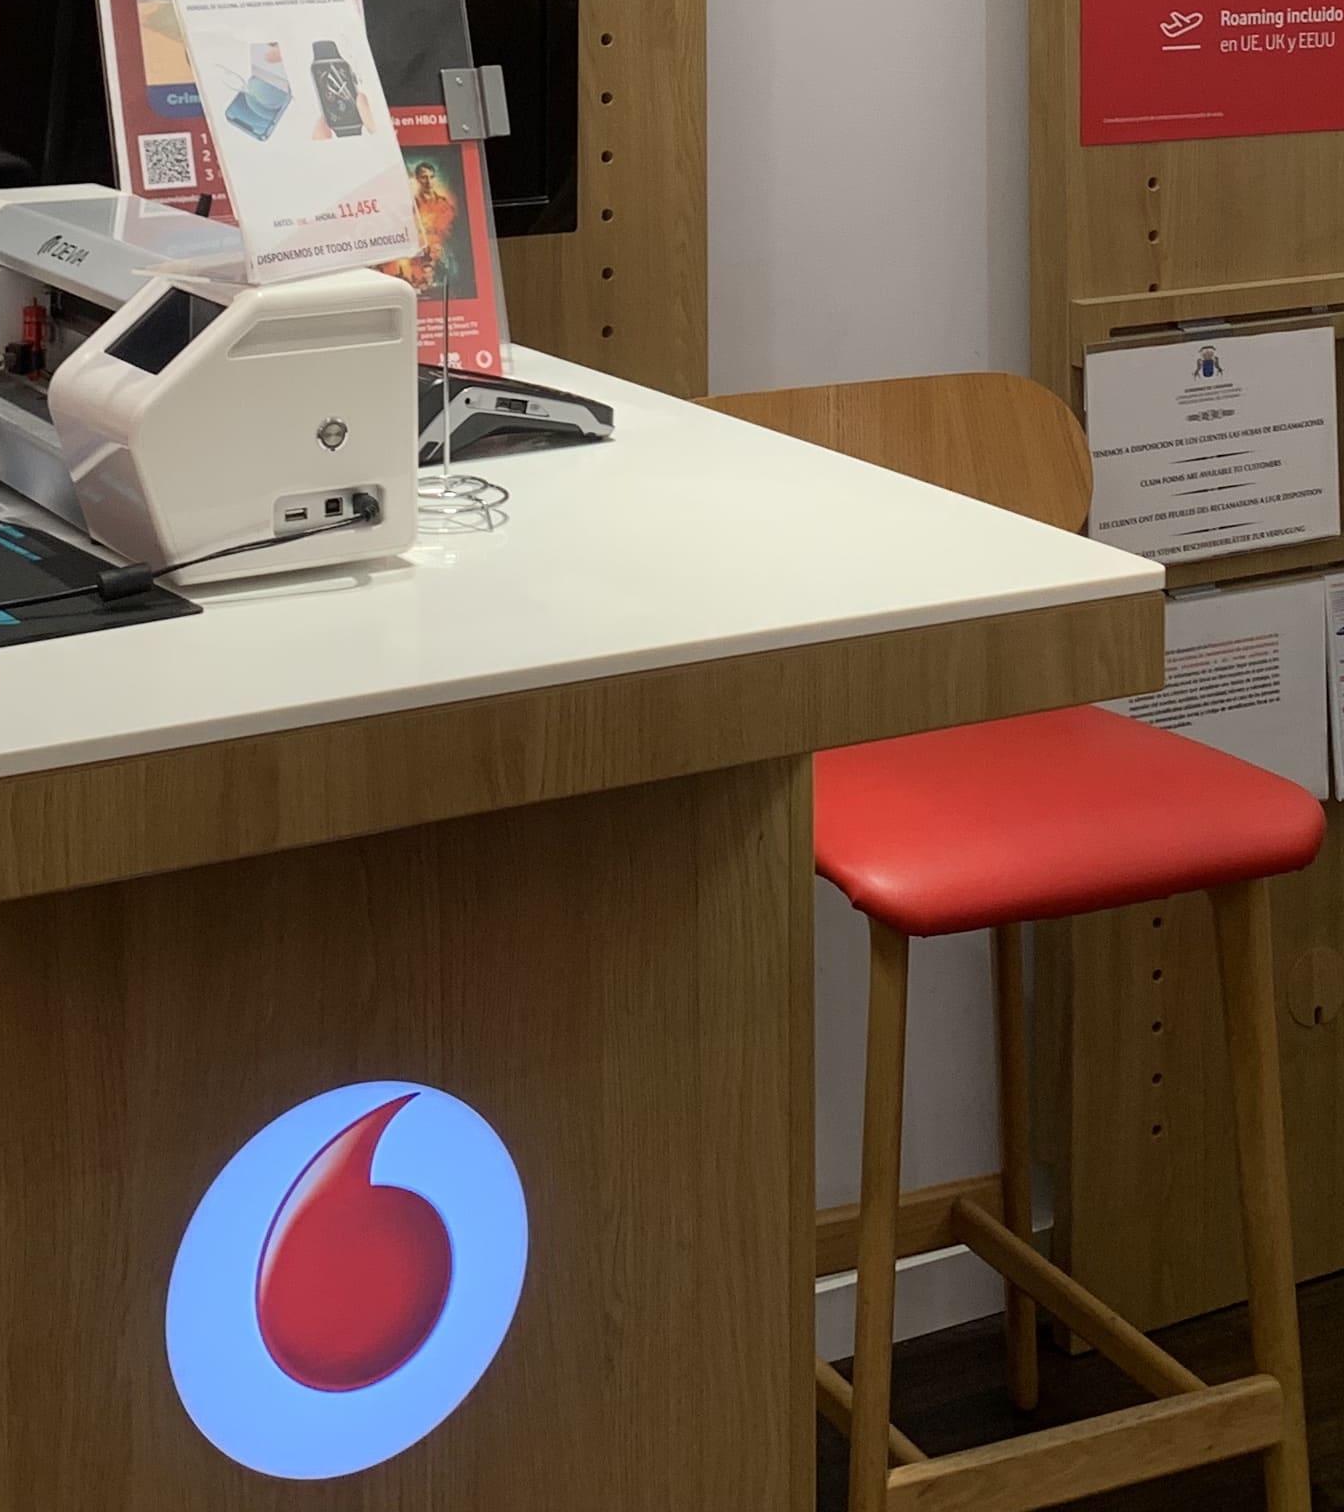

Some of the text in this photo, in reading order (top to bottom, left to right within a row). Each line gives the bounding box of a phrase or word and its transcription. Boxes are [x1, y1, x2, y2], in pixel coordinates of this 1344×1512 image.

[1220, 6, 1344, 29] Roaming incluido
[1220, 31, 1336, 54] en UE, UK y EEUU
[338, 199, 381, 218] 11,45€
[257, 247, 313, 266] DISPONEMOS
[314, 245, 326, 256] DE
[326, 240, 353, 255] TODOS
[355, 238, 369, 251] LOS
